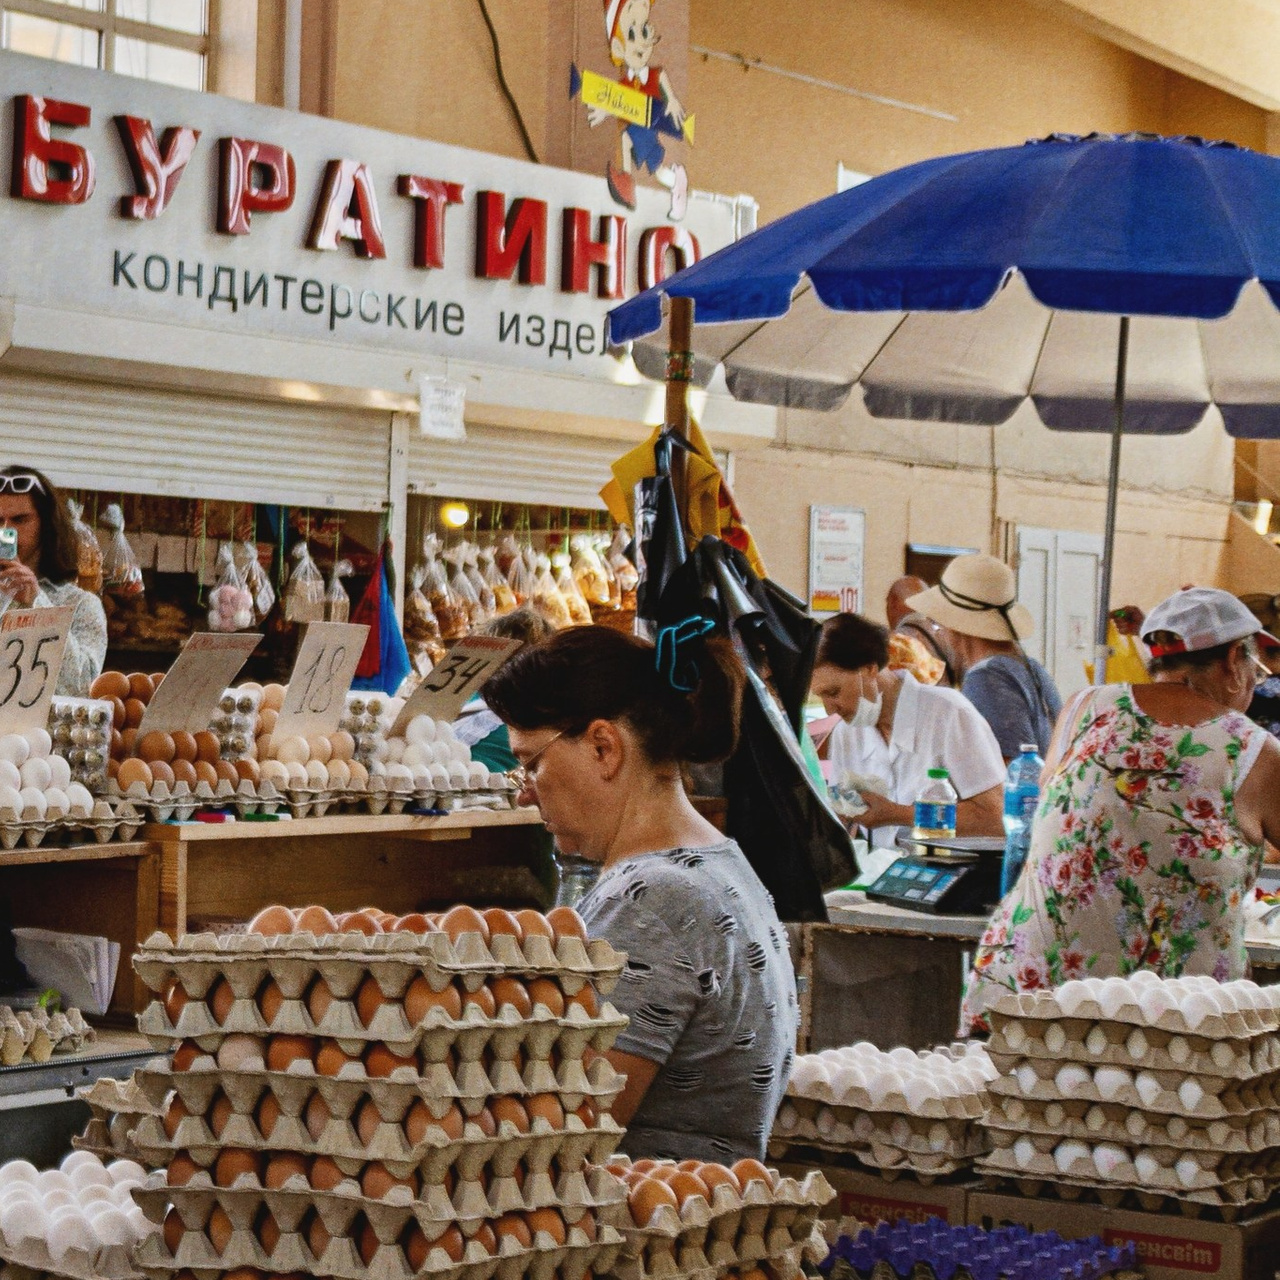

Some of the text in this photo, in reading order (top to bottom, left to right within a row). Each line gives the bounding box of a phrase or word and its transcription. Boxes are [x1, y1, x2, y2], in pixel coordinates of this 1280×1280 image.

[11, 93, 701, 300] БУРАТИНО
[113, 249, 465, 336] кондитерские
[293, 643, 346, 714] 18
[424, 655, 491, 695] 34
